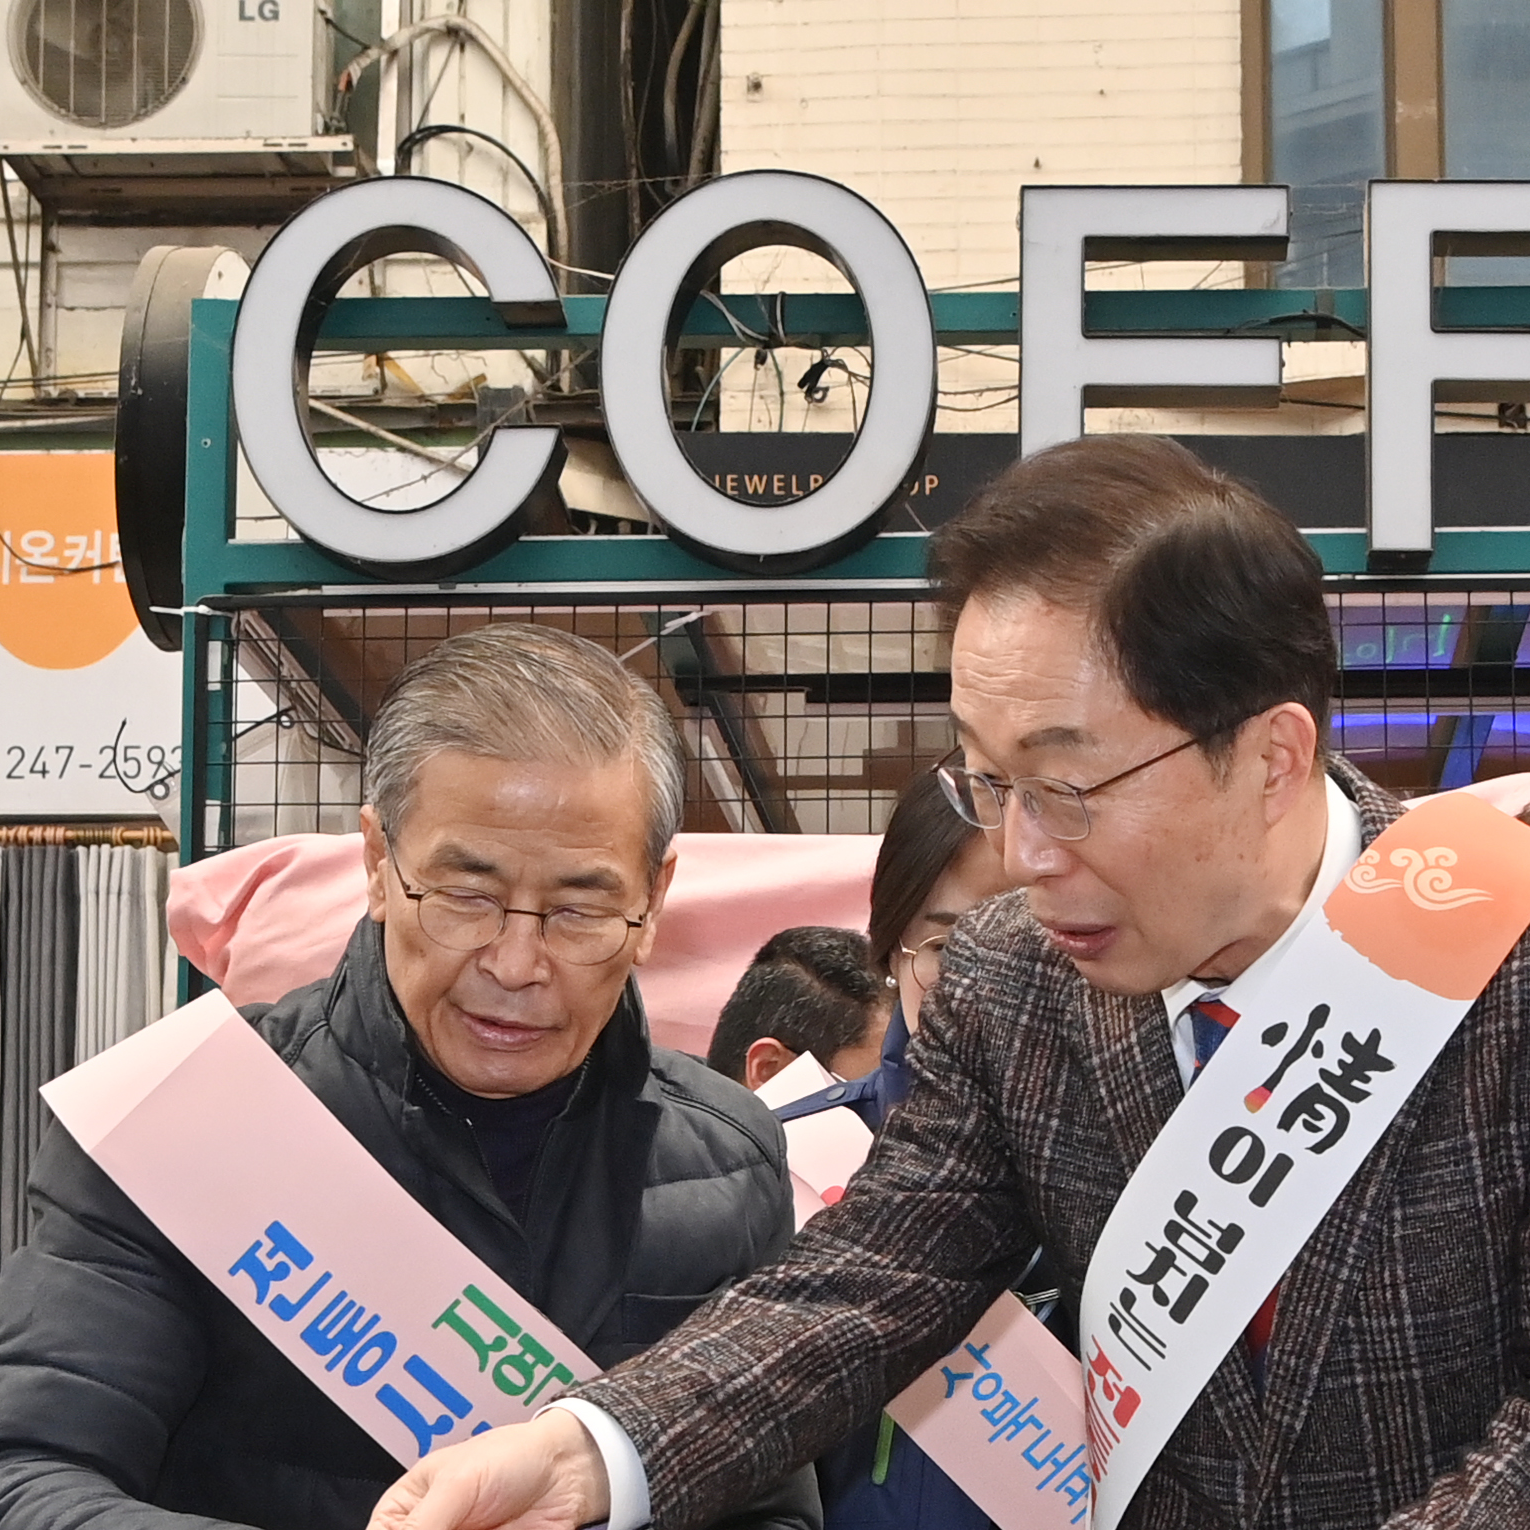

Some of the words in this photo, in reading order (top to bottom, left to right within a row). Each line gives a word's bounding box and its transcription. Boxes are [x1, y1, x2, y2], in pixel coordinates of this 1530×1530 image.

[238, 0, 280, 21] LG
[228, 1220, 492, 1459] 전통시
[431, 1284, 576, 1407] 지역
